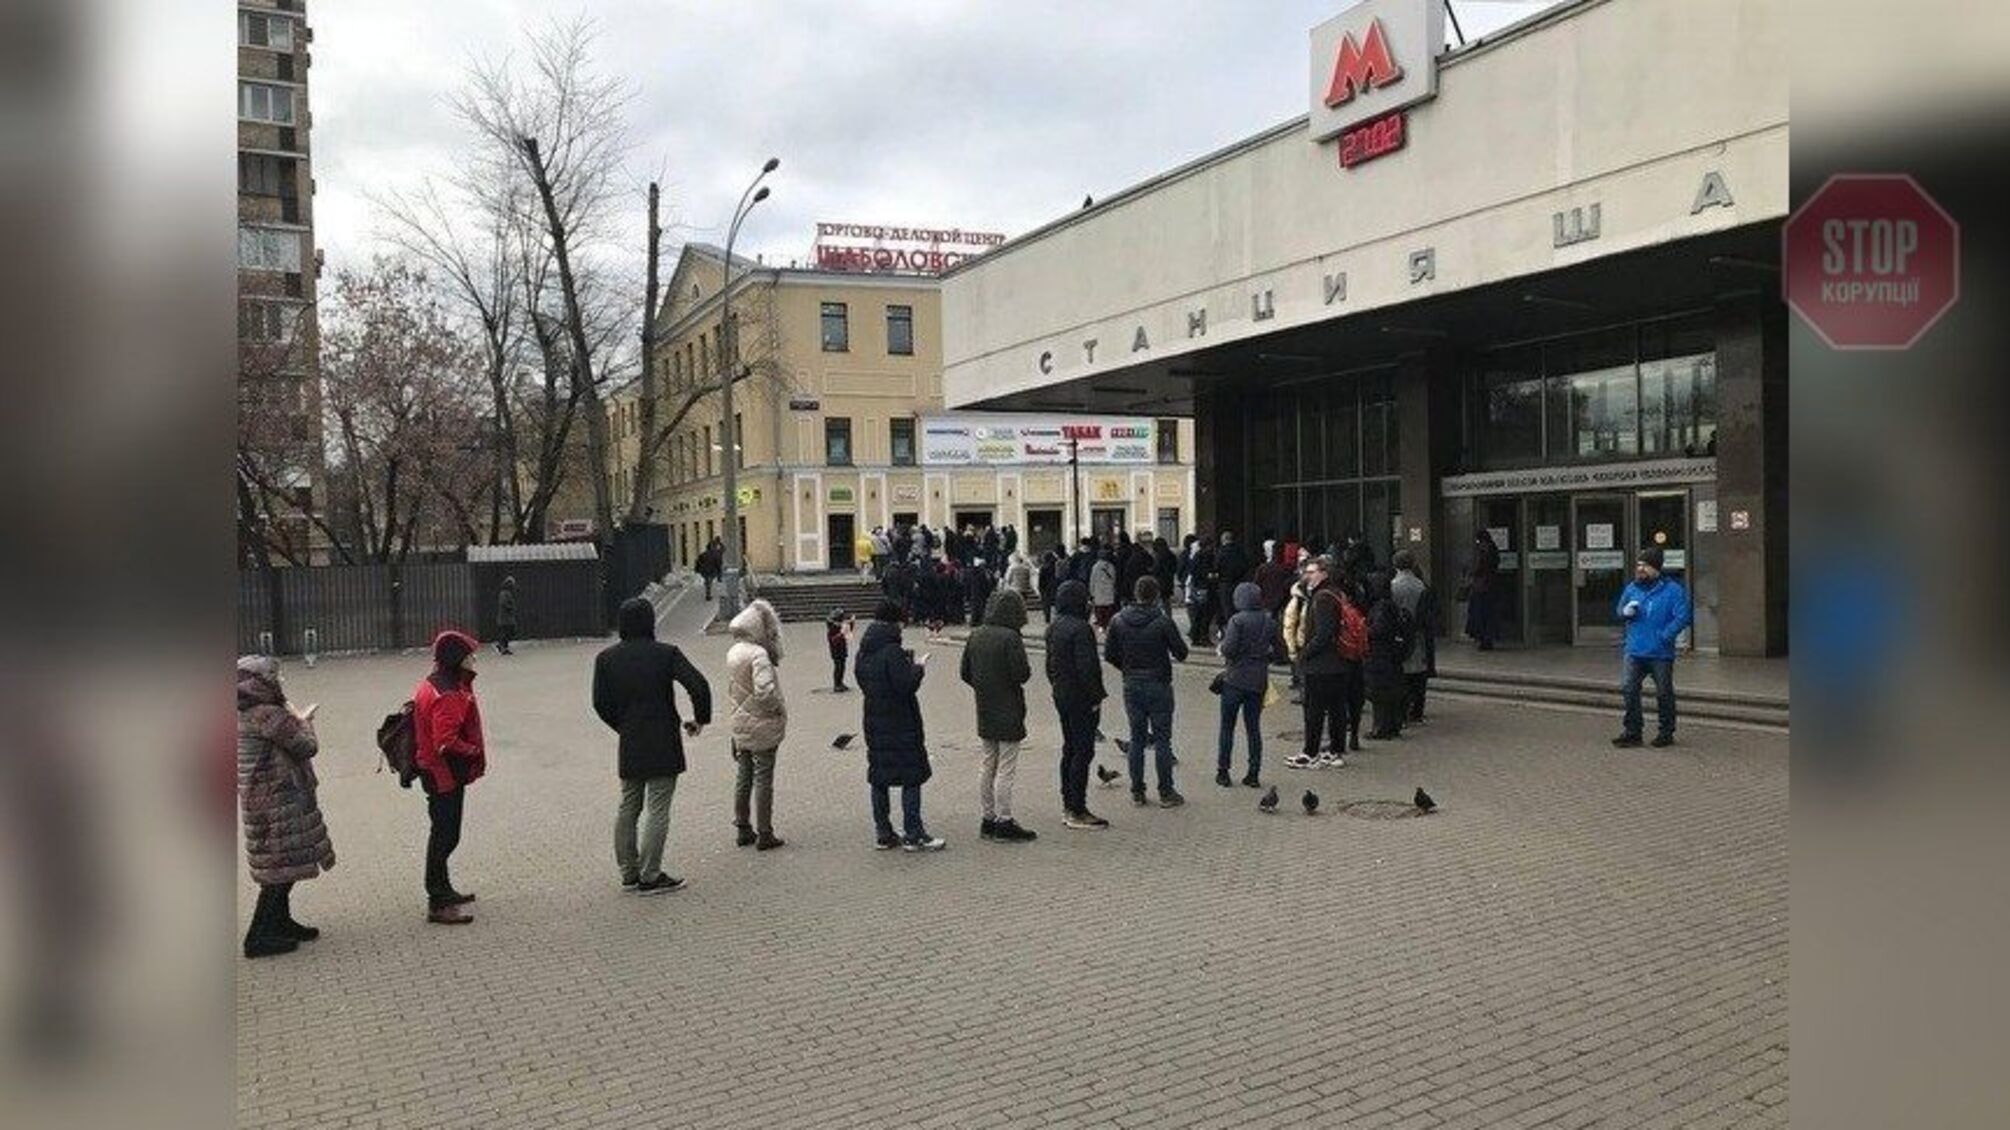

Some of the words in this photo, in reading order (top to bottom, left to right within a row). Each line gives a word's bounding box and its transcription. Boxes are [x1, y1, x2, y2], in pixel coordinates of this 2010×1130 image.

[1325, 17, 1404, 110] М
[816, 222, 962, 244] ТОРГОВО-ДЕЛОВОЙ
[964, 231, 1007, 246] ЦЕНТР
[1040, 247, 1437, 375] СТАНЦИЯ
